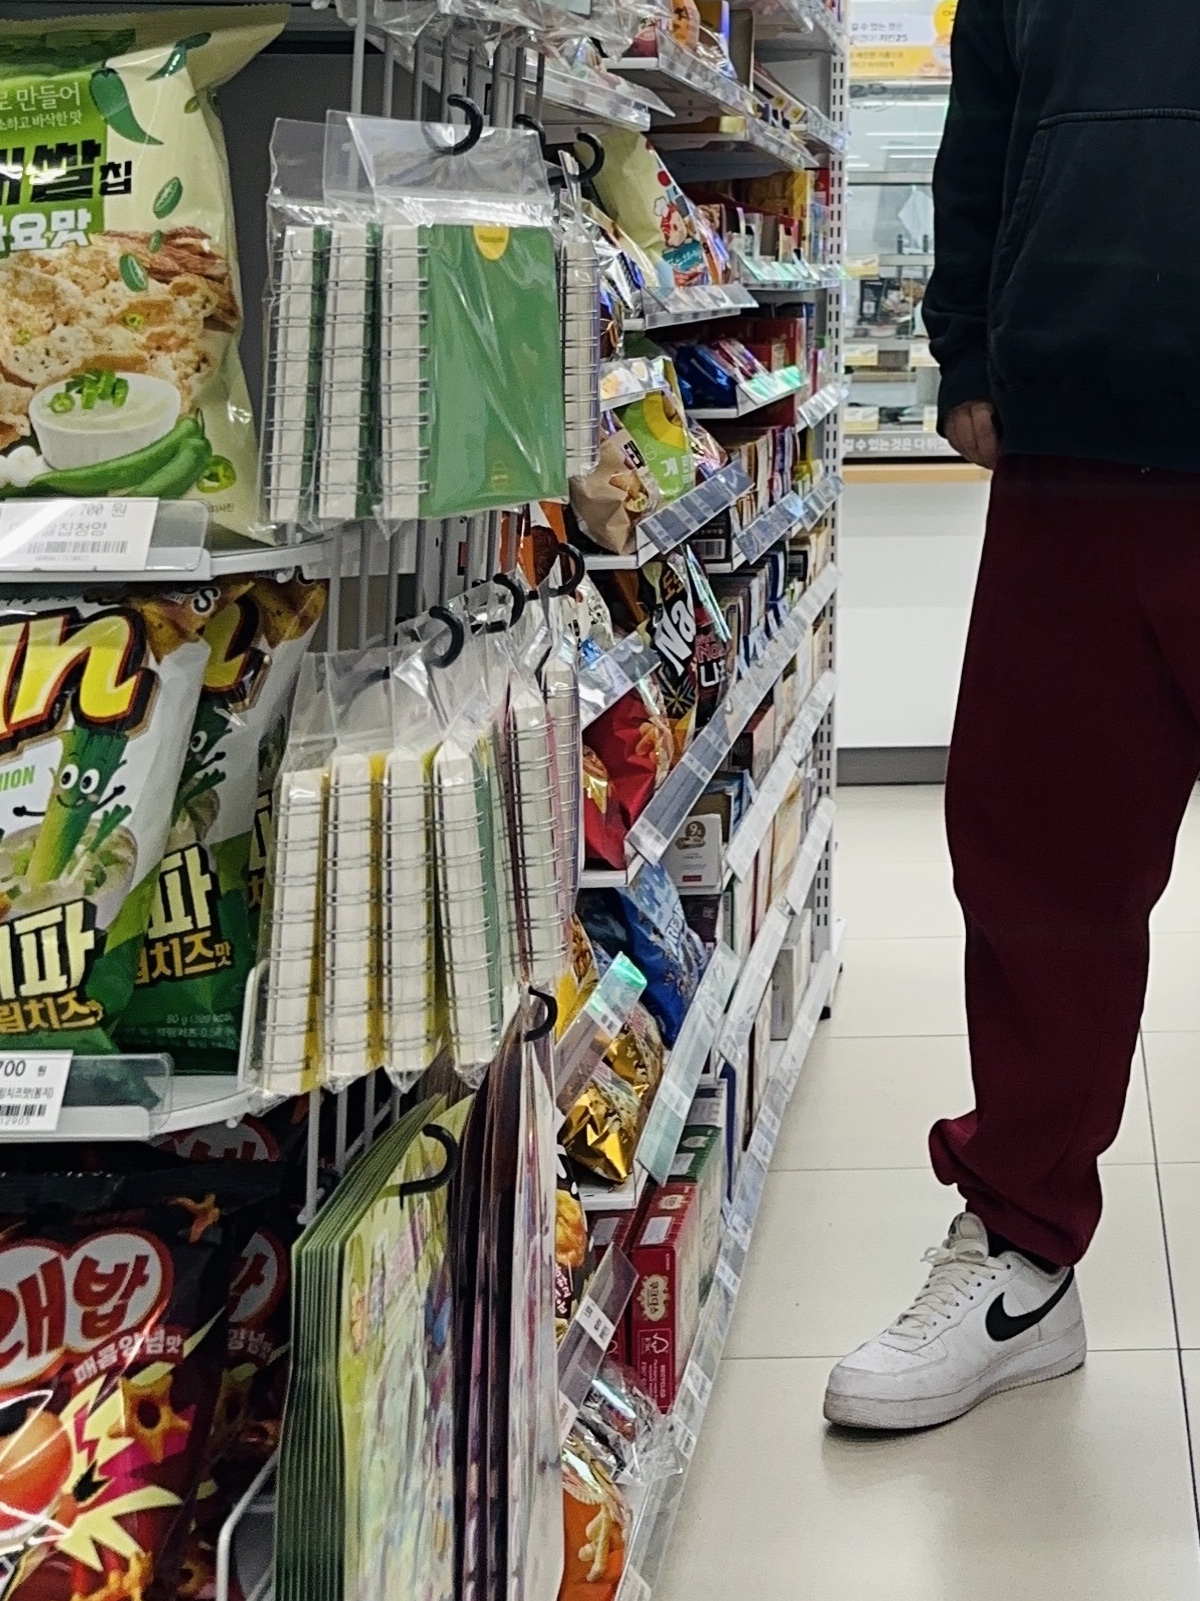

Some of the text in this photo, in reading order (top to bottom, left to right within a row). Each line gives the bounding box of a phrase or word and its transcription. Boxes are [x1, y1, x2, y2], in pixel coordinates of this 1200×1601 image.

[16, 82, 81, 112] 만들어
[31, 111, 69, 129] 바삭한
[70, 109, 83, 125] 맛
